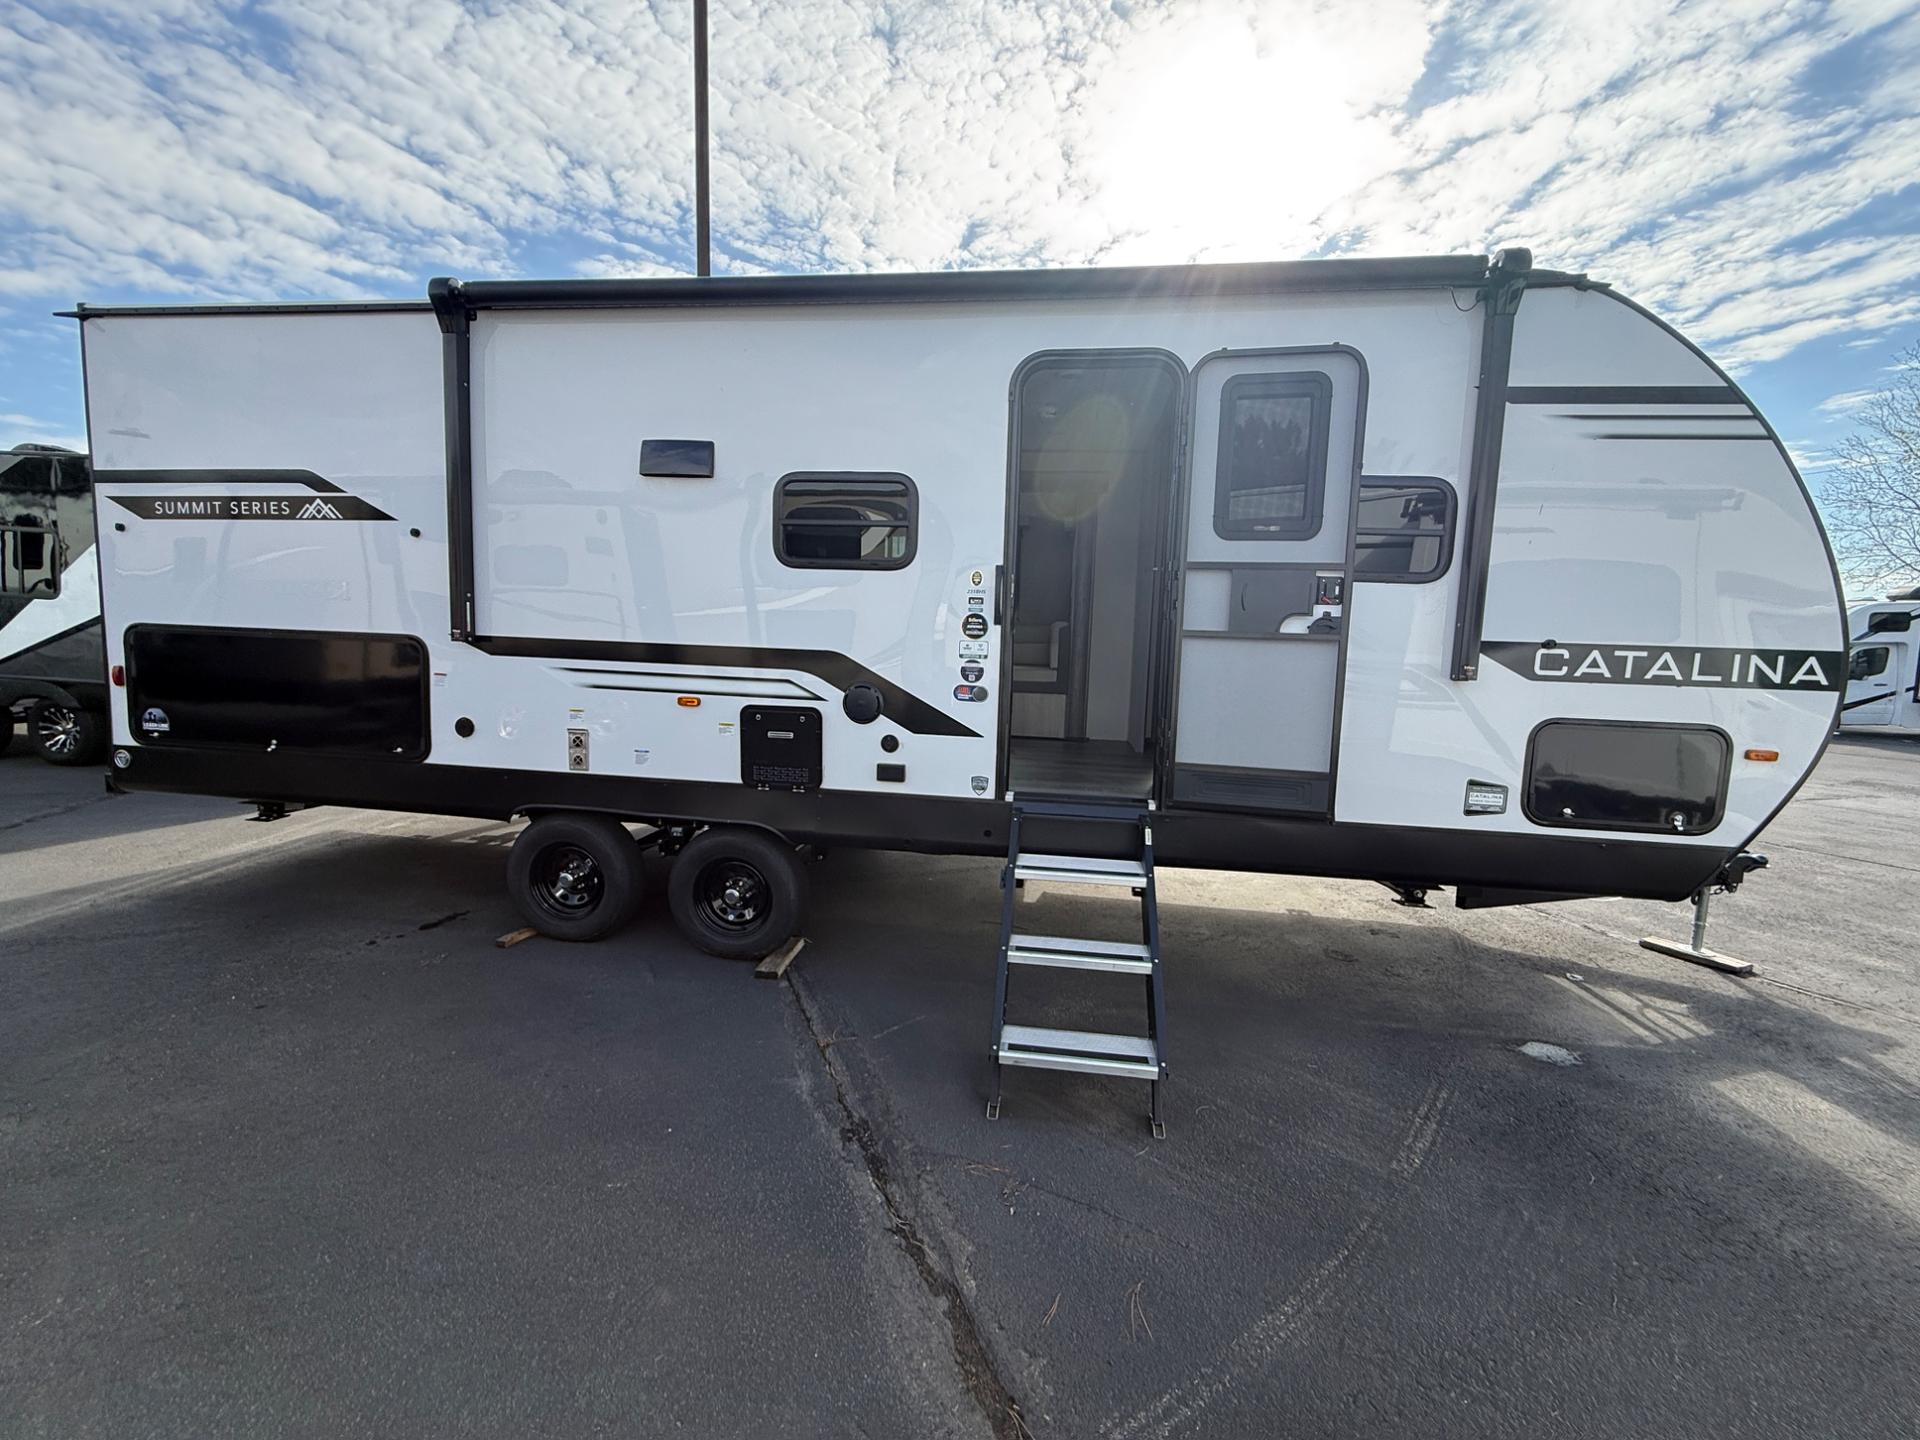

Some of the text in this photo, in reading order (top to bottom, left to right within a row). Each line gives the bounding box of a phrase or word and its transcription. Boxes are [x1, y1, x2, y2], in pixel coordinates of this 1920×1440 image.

[154, 501, 291, 515] SUMMIT SERIES
[1533, 648, 1829, 686] CATALINA
